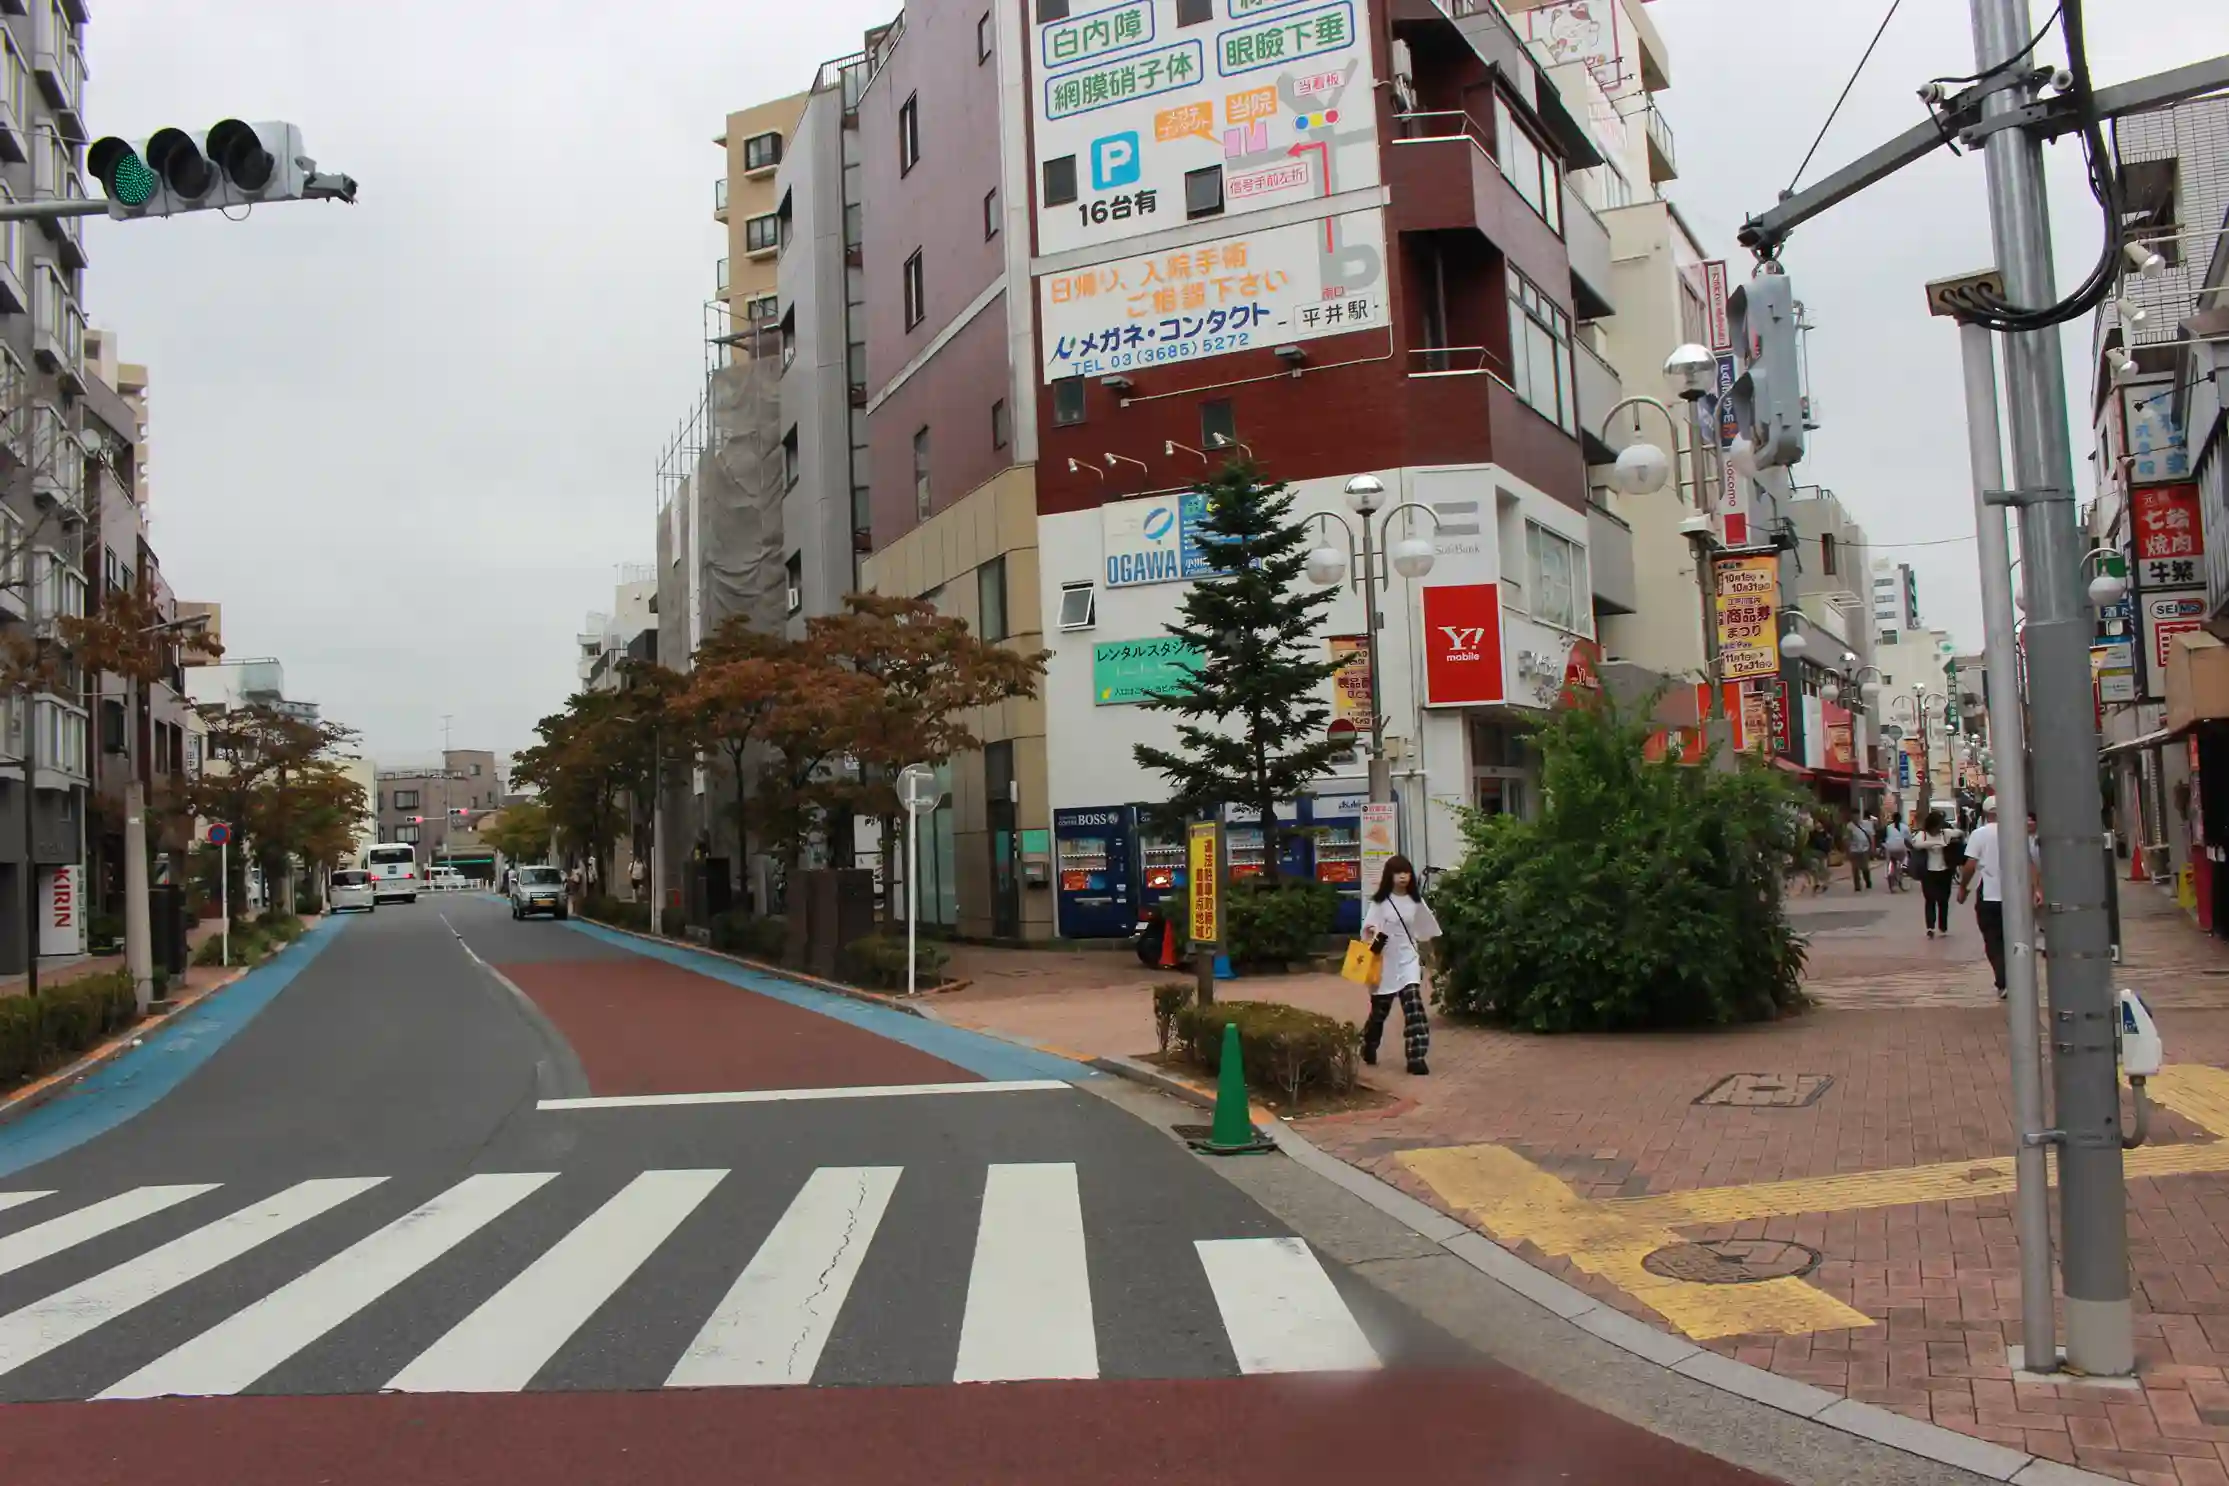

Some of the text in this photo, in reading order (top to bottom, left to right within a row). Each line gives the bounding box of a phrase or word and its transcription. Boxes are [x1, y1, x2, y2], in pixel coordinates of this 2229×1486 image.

[1053, 8, 1143, 59] 白内障
[1053, 51, 1194, 112] 網膜硝子体
[1230, 92, 1274, 120] 当院
[1100, 140, 1132, 184] P
[1230, 170, 1305, 194] 信号手前左折
[1079, 189, 1157, 227] 16台有
[1302, 299, 1368, 328] 平井駅
[1079, 302, 1270, 357] メガネ・コンタクト
[1071, 359, 1105, 376] TEL
[2145, 532, 2192, 556] 焼肉
[1107, 550, 1178, 584] OGAWA
[1438, 626, 1485, 651] Y!
[1728, 625, 1761, 639] まつり
[1446, 651, 1480, 662] mobile
[1078, 813, 1107, 826] BOSS
[53, 867, 72, 928] KIRIN
